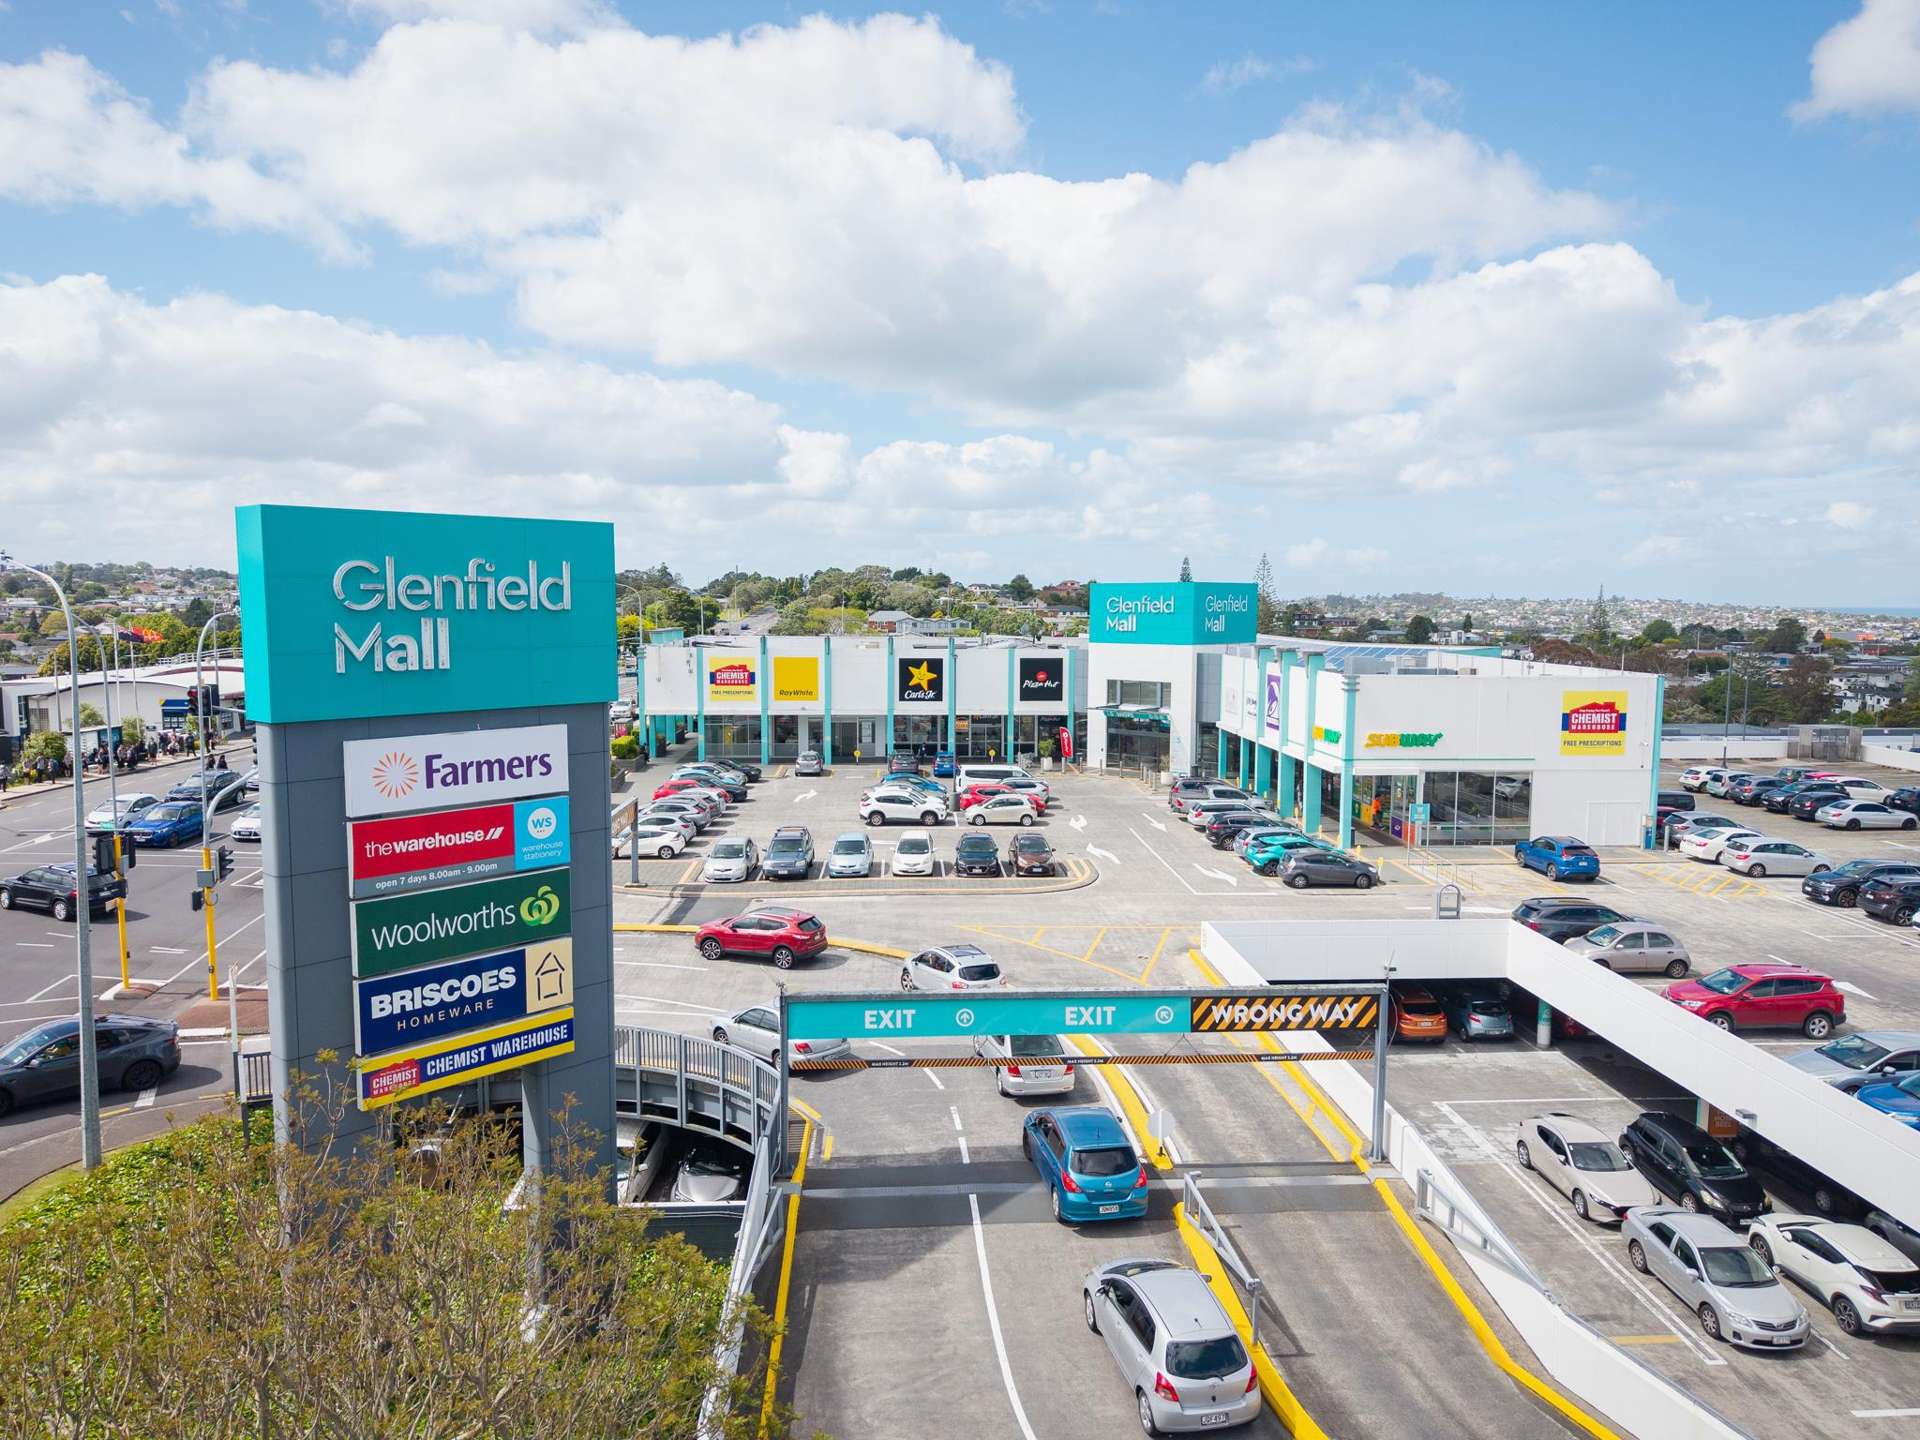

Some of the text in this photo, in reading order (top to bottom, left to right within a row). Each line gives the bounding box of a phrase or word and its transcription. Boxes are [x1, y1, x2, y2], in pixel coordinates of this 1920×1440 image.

[333, 556, 571, 611] Glenfield
[1106, 595, 1175, 614] Glenfield
[1205, 594, 1248, 612] Glenfield
[1106, 614, 1137, 632] Mall
[1205, 615, 1225, 632] Mall
[334, 617, 450, 673] Mall
[716, 672, 748, 680] CHEMIST
[1571, 713, 1617, 724] CHEMIST
[1364, 732, 1444, 748] SUBWAY
[424, 751, 552, 789] Farmers
[532, 817, 552, 829] WS
[522, 841, 564, 852] warehouse
[523, 849, 562, 860] stationery
[376, 879, 397, 890] open
[400, 877, 406, 885] 7
[408, 873, 427, 884] days
[429, 869, 461, 880] 8.00am
[466, 863, 498, 874] 9.00pm
[371, 901, 516, 951] Woolworths
[371, 966, 517, 1020] BRISCOES
[397, 998, 495, 1031] HOMEWARE
[864, 1009, 916, 1030] EXIT
[1065, 1006, 1116, 1026] EXIT
[1212, 1003, 1359, 1024] WRONG WAY
[426, 1024, 568, 1077] CHEMIST WAREHOUSE
[372, 1068, 418, 1089] CHEMIST
